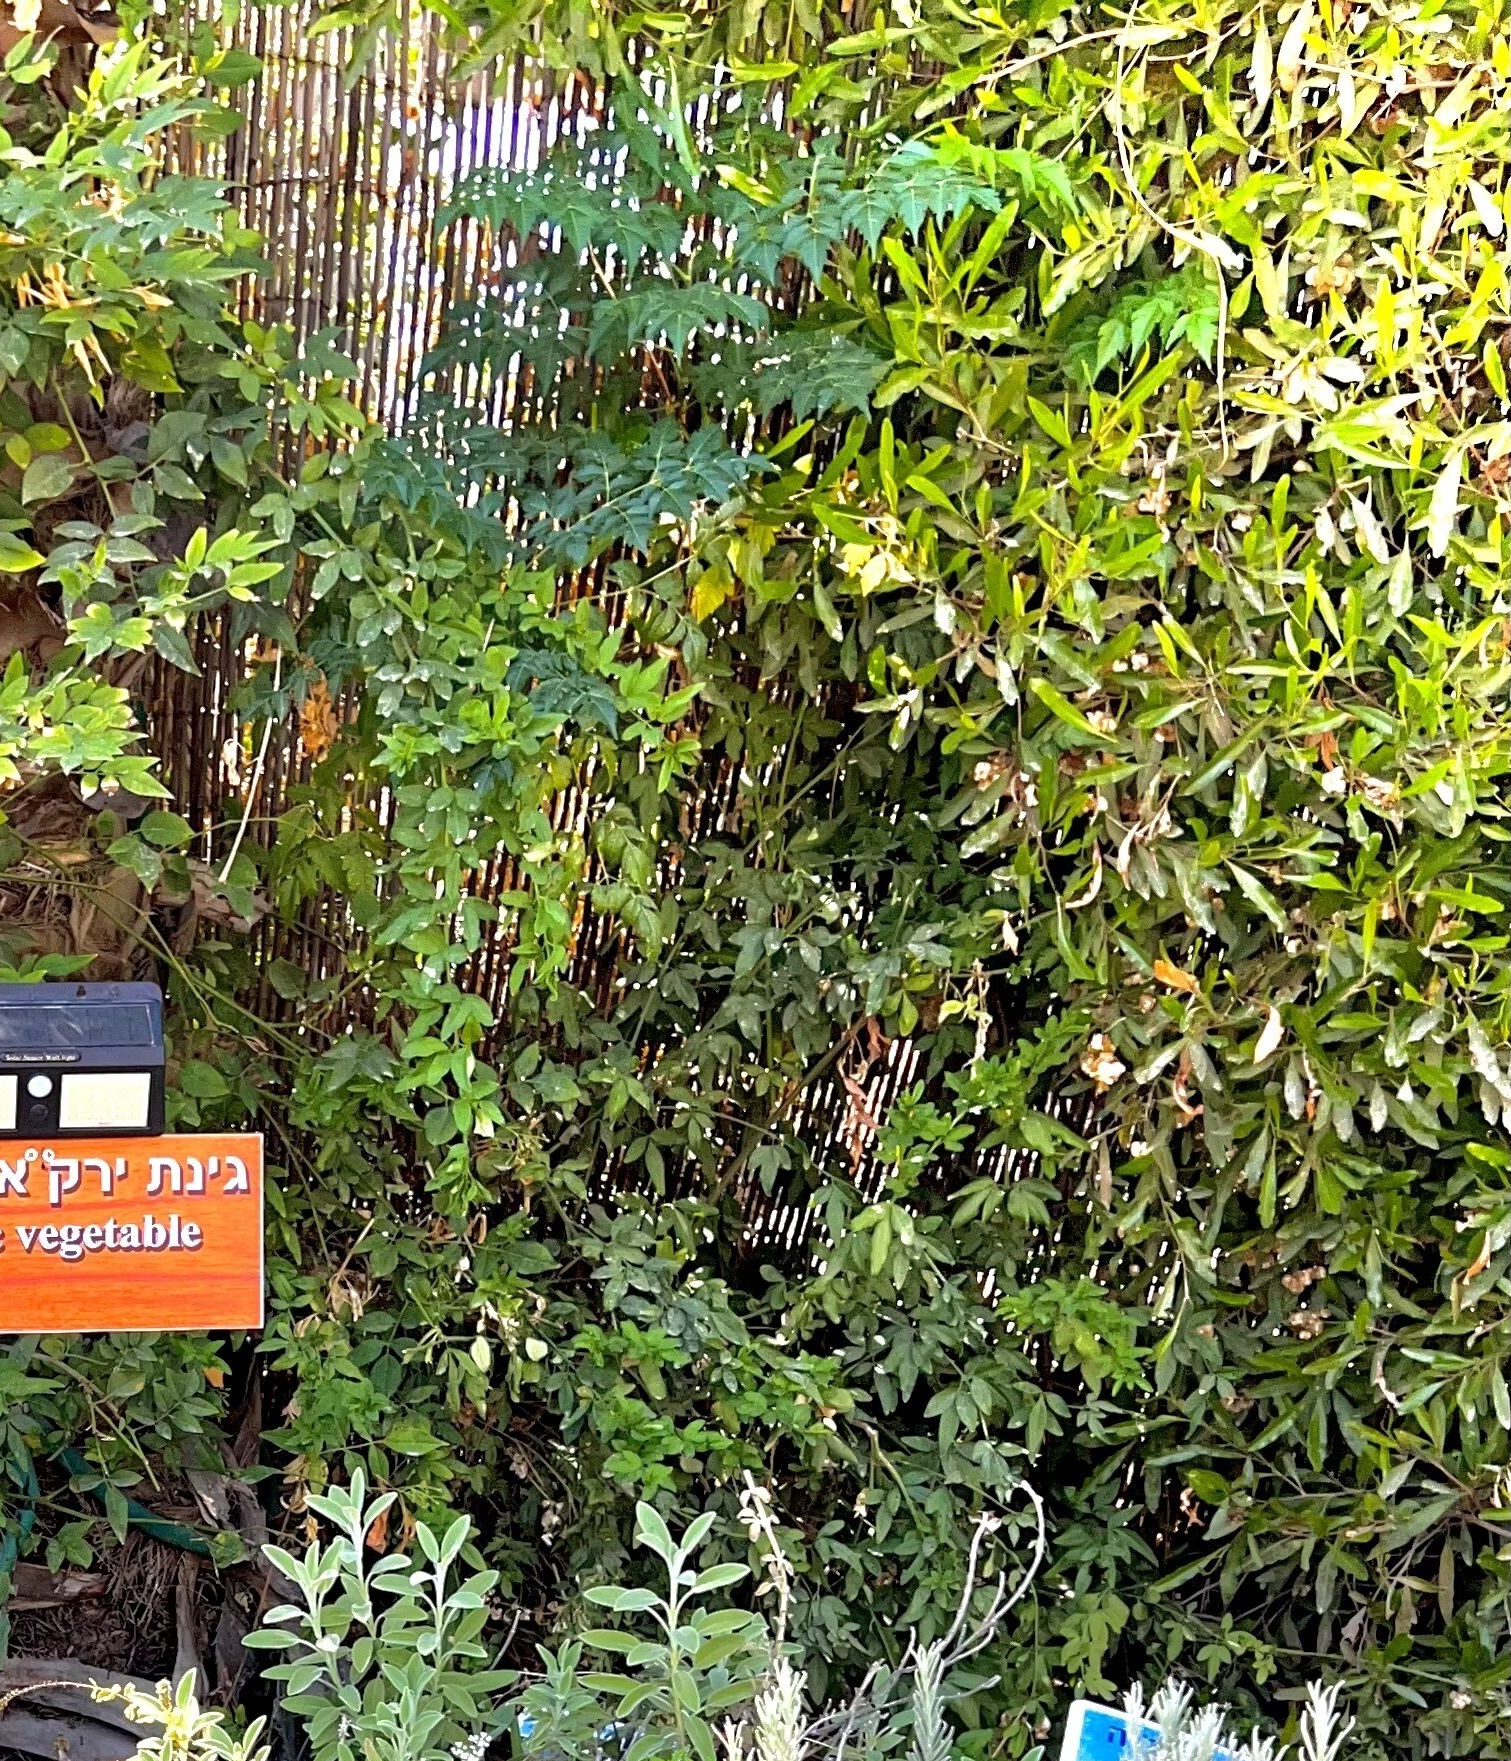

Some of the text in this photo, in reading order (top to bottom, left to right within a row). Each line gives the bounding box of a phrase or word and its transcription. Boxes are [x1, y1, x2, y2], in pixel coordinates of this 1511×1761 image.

[48, 1155, 128, 1206] ירק
[147, 1154, 250, 1194] גינת
[15, 1213, 203, 1260] vegetable
